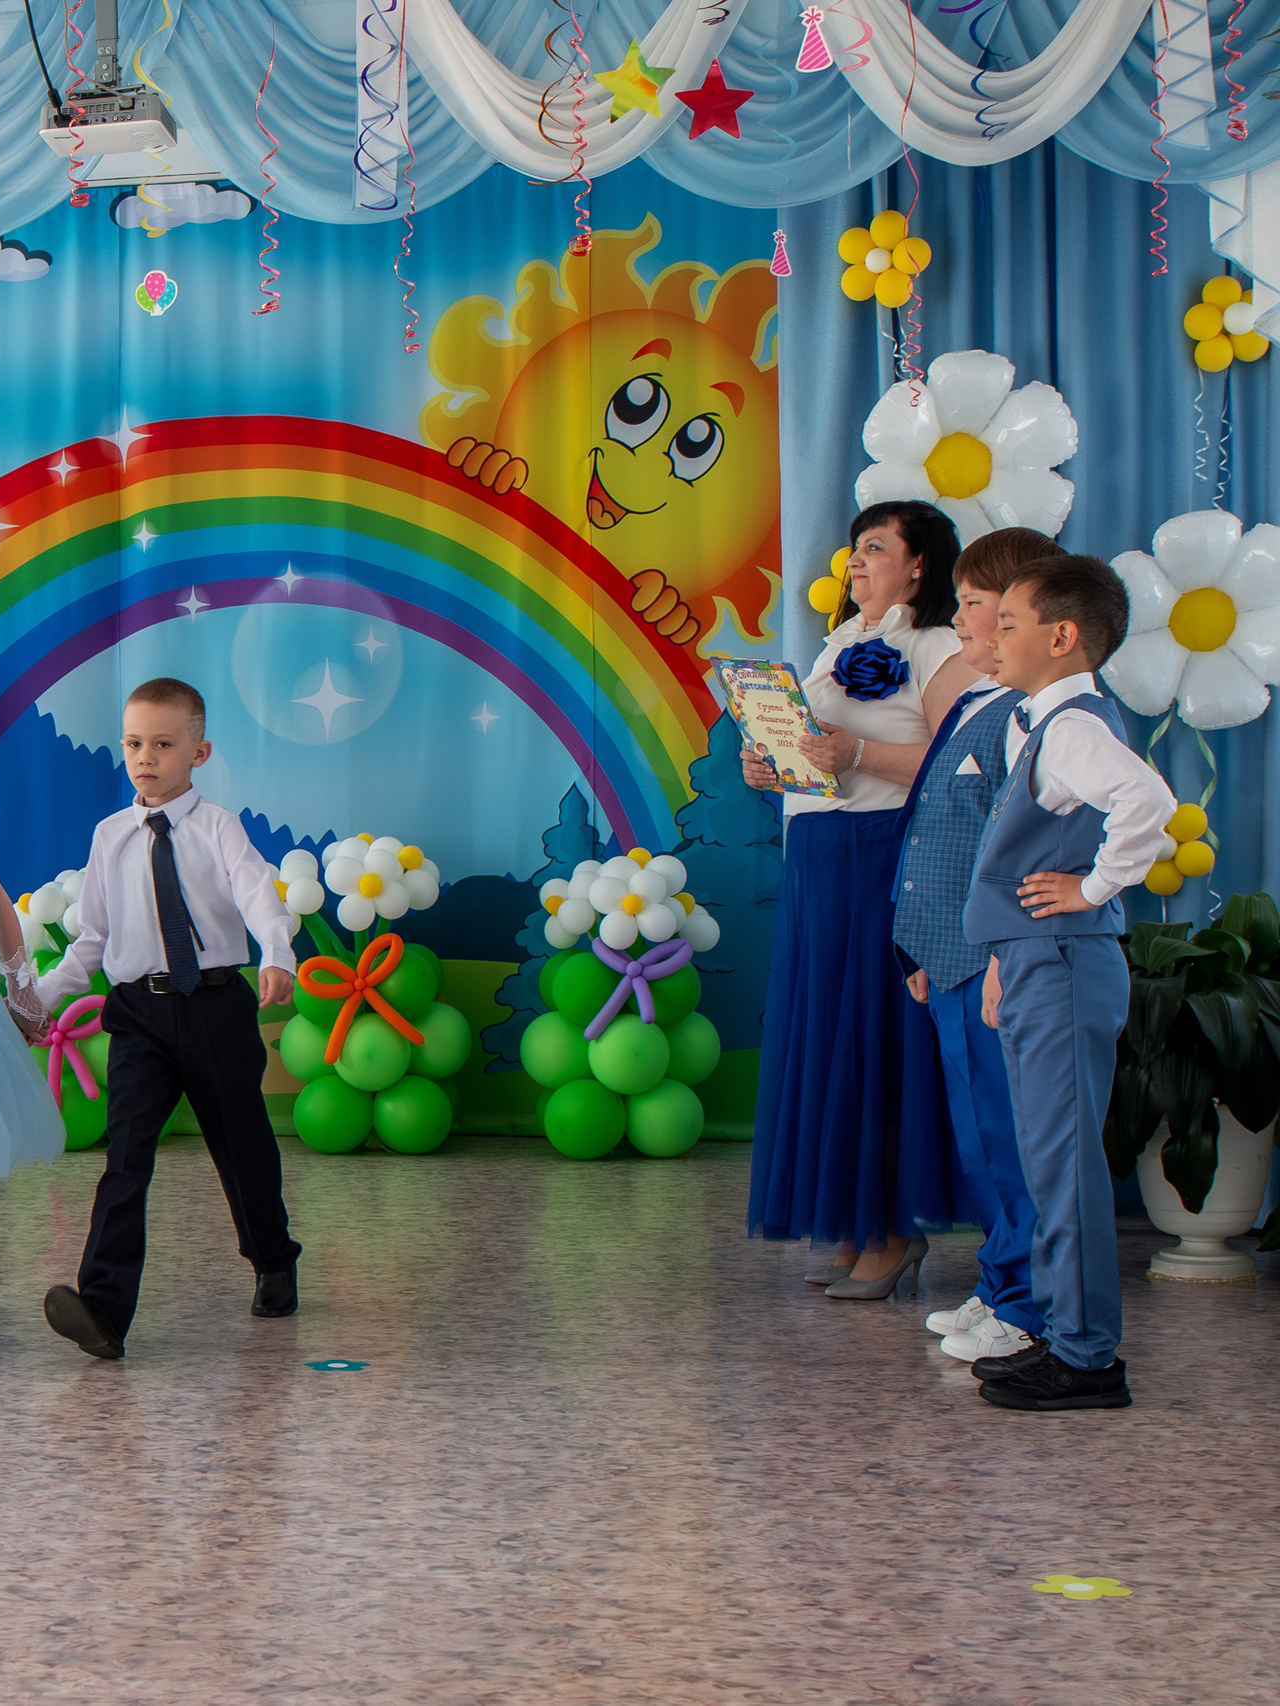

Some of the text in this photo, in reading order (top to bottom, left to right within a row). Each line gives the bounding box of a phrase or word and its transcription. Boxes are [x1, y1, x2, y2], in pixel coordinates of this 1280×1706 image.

[739, 681, 773, 691] Детский
[756, 702, 784, 713] Группа
[765, 726, 797, 738] Выпуск
[776, 739, 794, 748] 2026
